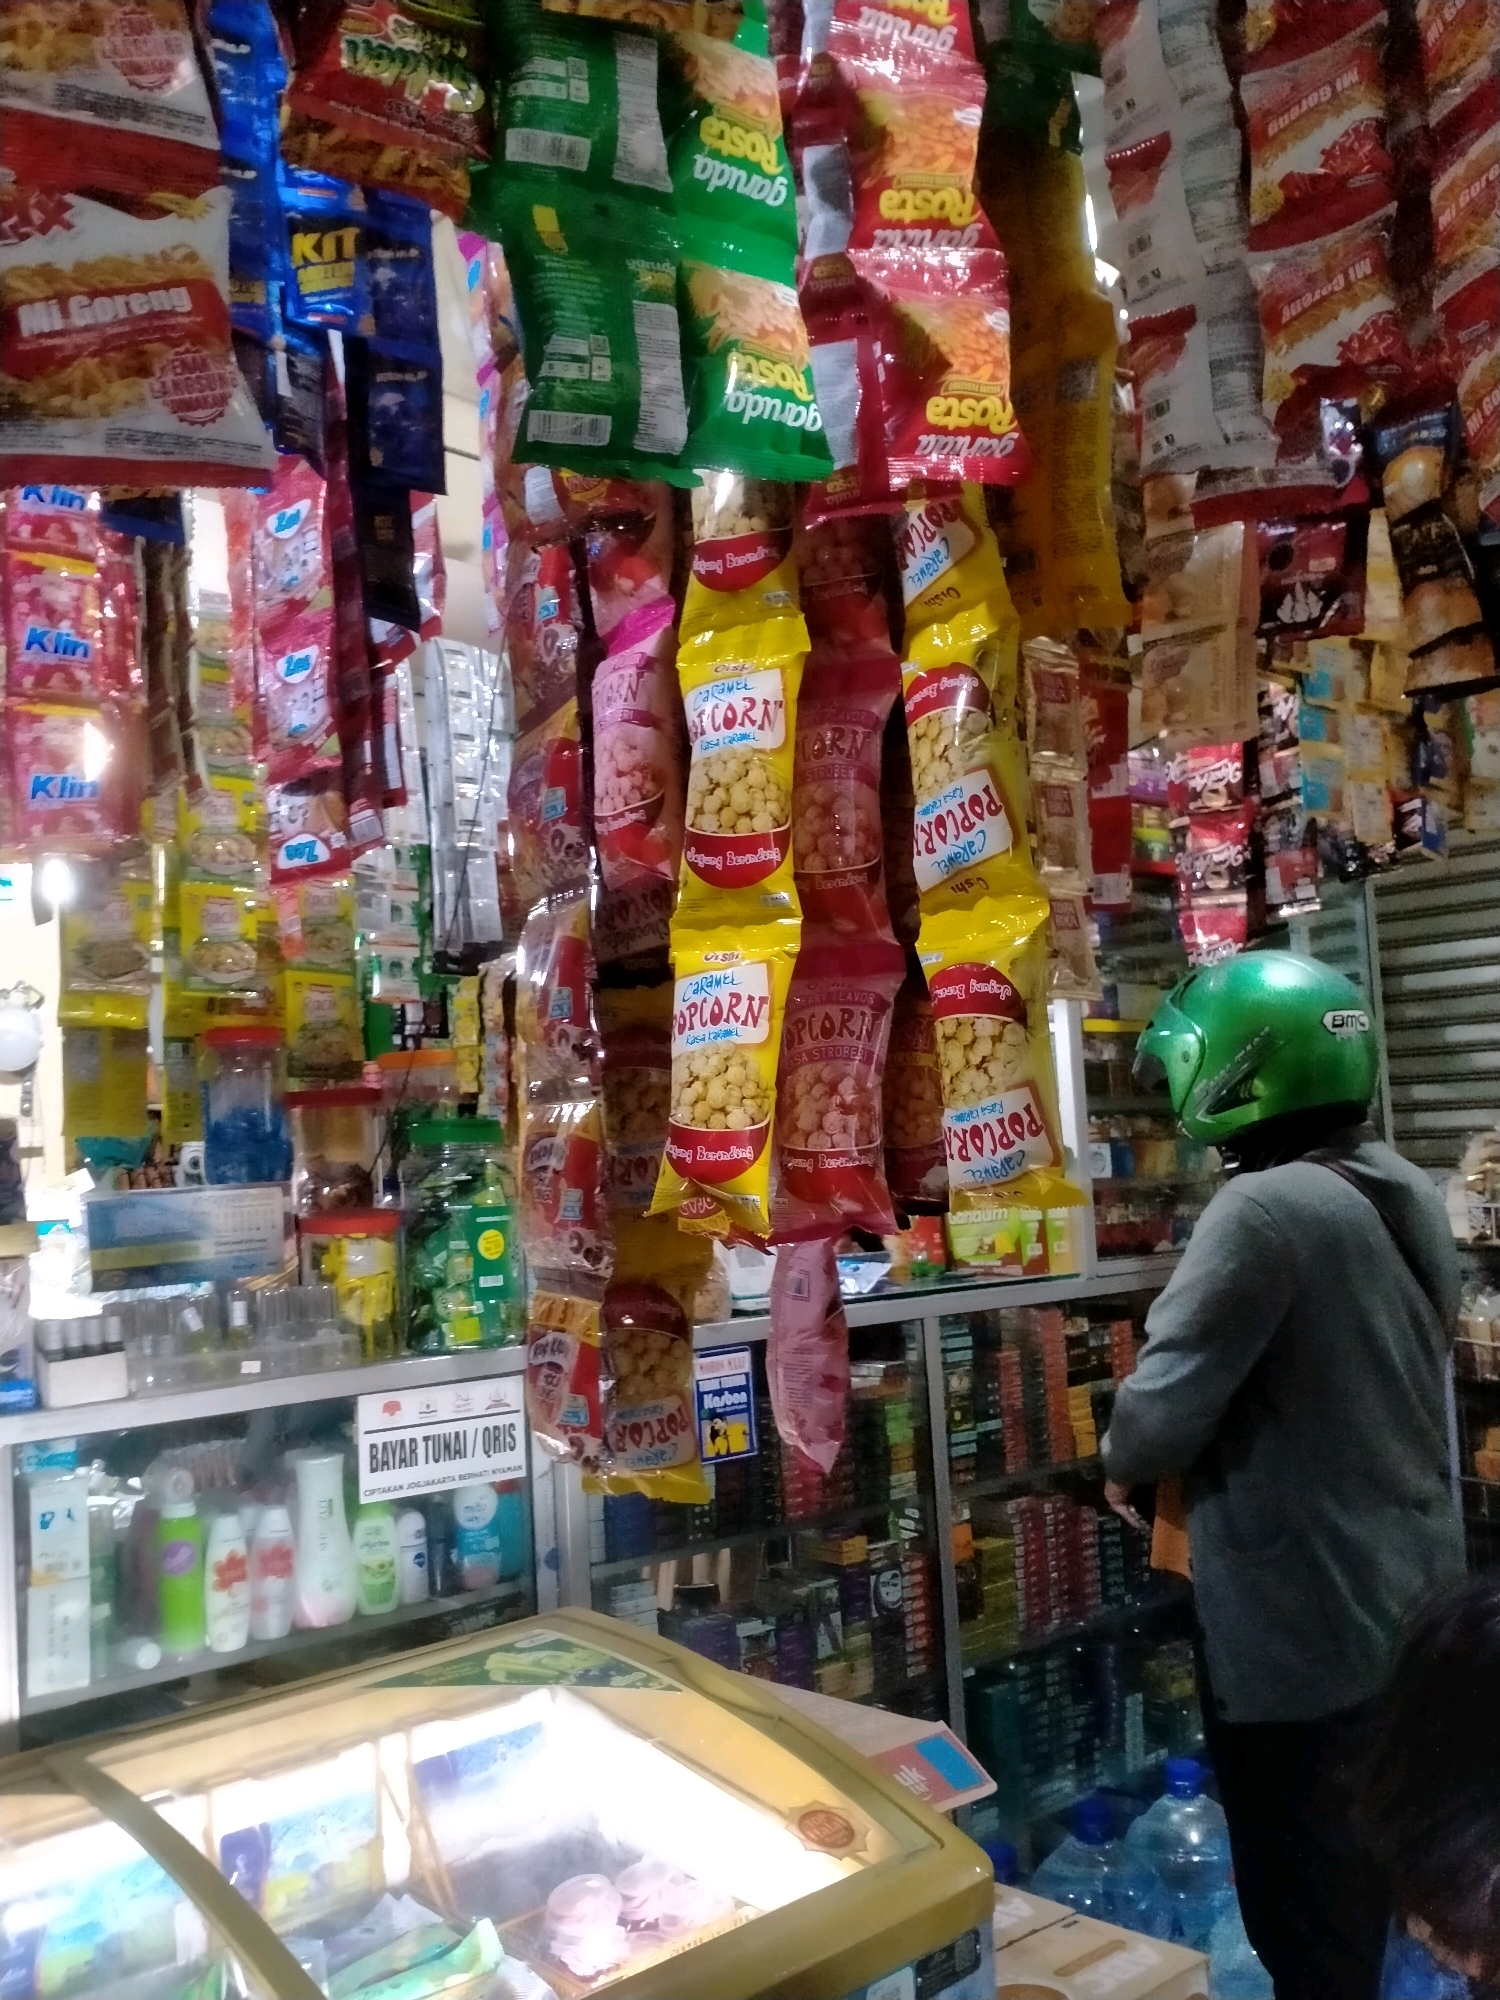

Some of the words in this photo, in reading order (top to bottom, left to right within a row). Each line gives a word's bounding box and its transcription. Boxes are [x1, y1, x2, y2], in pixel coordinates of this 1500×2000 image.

[860, 6, 958, 52] garuda
[700, 115, 784, 175] Rosta
[693, 153, 788, 207] garuda
[879, 187, 982, 227] Rosta
[292, 226, 360, 269] KIT
[872, 223, 983, 250] garuda
[18, 299, 62, 337] Mi
[69, 286, 193, 327] Goreng
[727, 350, 814, 401] Rosta
[726, 391, 821, 433] garuda
[925, 396, 1016, 434] Rosta
[917, 432, 1020, 457] garuda
[23, 485, 87, 511] Klin
[924, 587, 961, 608] Oishi
[25, 626, 89, 659] Klin
[31, 775, 99, 800] Klin
[686, 847, 723, 870] Jagung
[727, 847, 782, 867] Berondong
[950, 876, 990, 896] Oishi
[704, 951, 742, 963] Oishi
[839, 992, 876, 1006] FLAVOR
[970, 977, 1012, 1001] Jagung
[1331, 1013, 1367, 1030] BMC
[813, 1046, 868, 1062] STROBERI
[696, 1145, 755, 1161] Berondong
[818, 1152, 875, 1169] Berondong
[369, 1437, 419, 1474] BAYAR
[422, 1429, 468, 1465] TUNAI
[471, 1428, 478, 1458] /
[482, 1422, 517, 1459] QRIS
[364, 1483, 405, 1498] CIPTAKAN
[405, 1475, 457, 1491] JOGJAKARTA
[458, 1469, 491, 1481] BERHATI
[491, 1464, 523, 1476] NYAMAN
